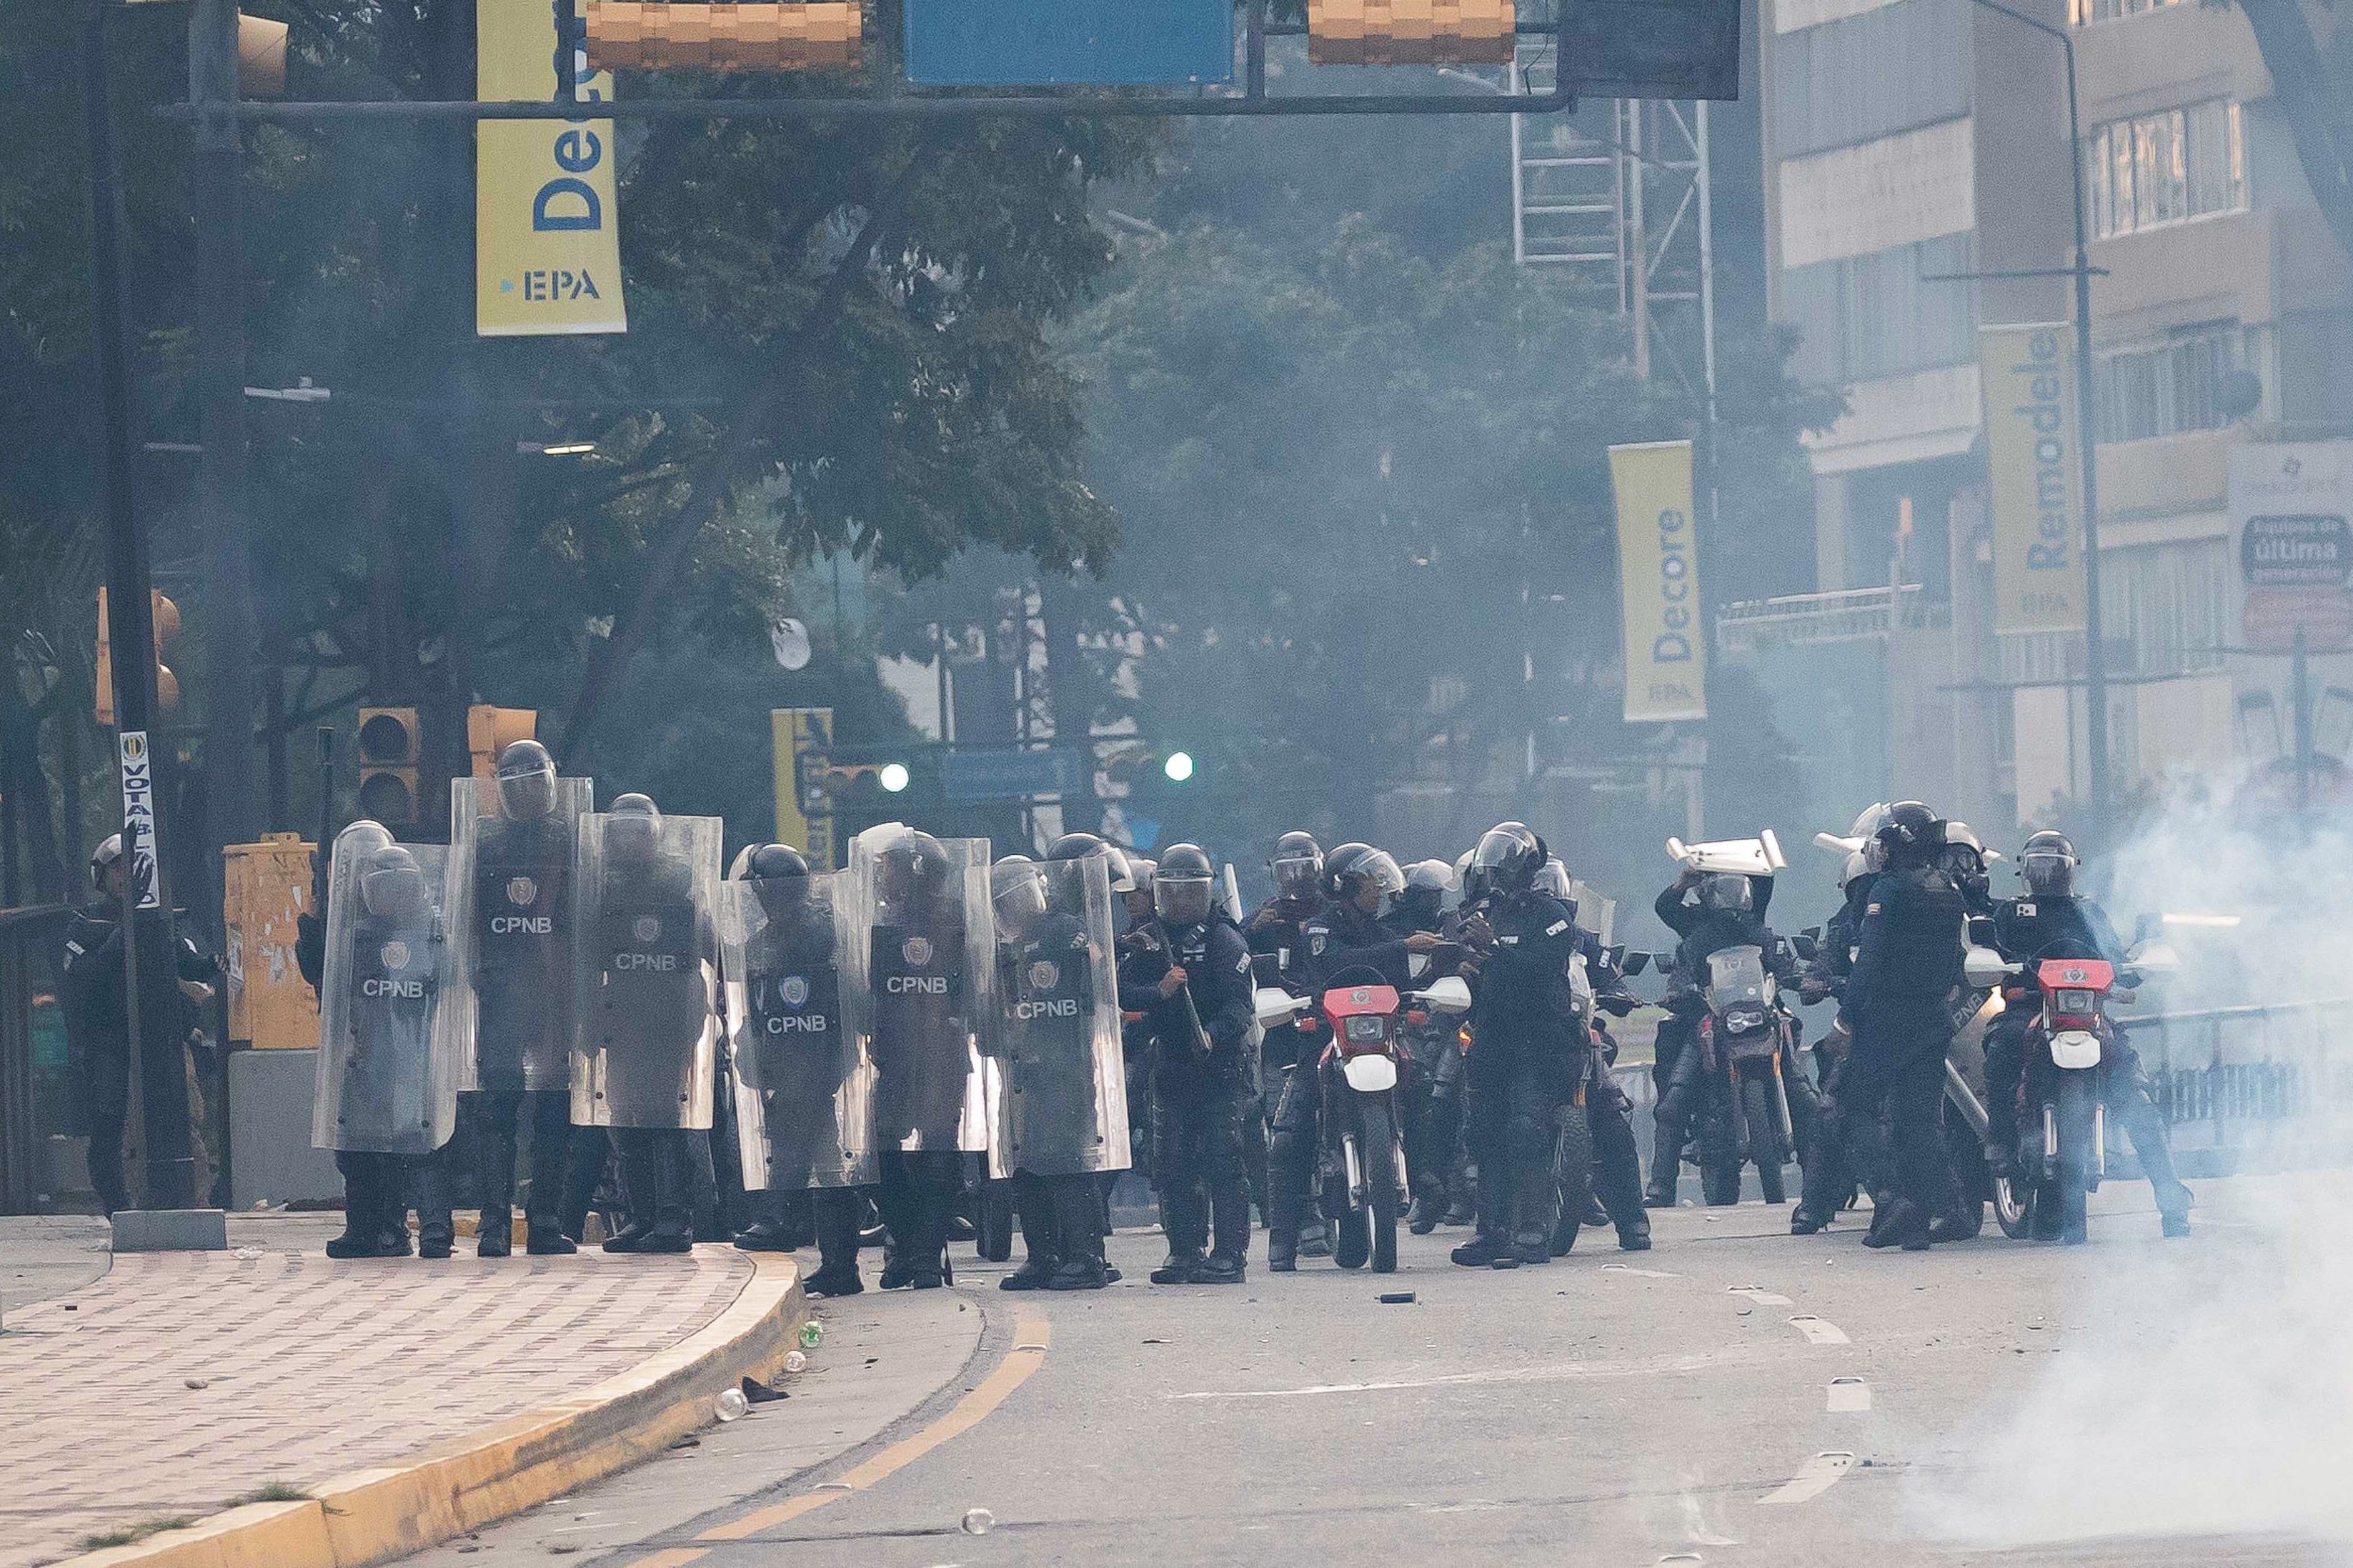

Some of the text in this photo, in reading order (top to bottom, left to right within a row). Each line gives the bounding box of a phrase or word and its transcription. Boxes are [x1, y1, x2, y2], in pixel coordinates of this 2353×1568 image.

[524, 269, 600, 301] EPA
[2011, 332, 2069, 570] Remodele
[2255, 537, 2337, 561] última
[1653, 507, 1692, 663] Decore
[1648, 683, 1692, 699] EPA
[124, 763, 151, 817] VOTA
[491, 917, 552, 934] CPNB
[615, 953, 677, 972] CPNB
[362, 979, 424, 999] CPNB
[887, 977, 948, 994] CPNB
[1017, 999, 1078, 1020] CPNB
[1952, 993, 1983, 1027] PNB
[767, 1015, 827, 1034] CPNB
